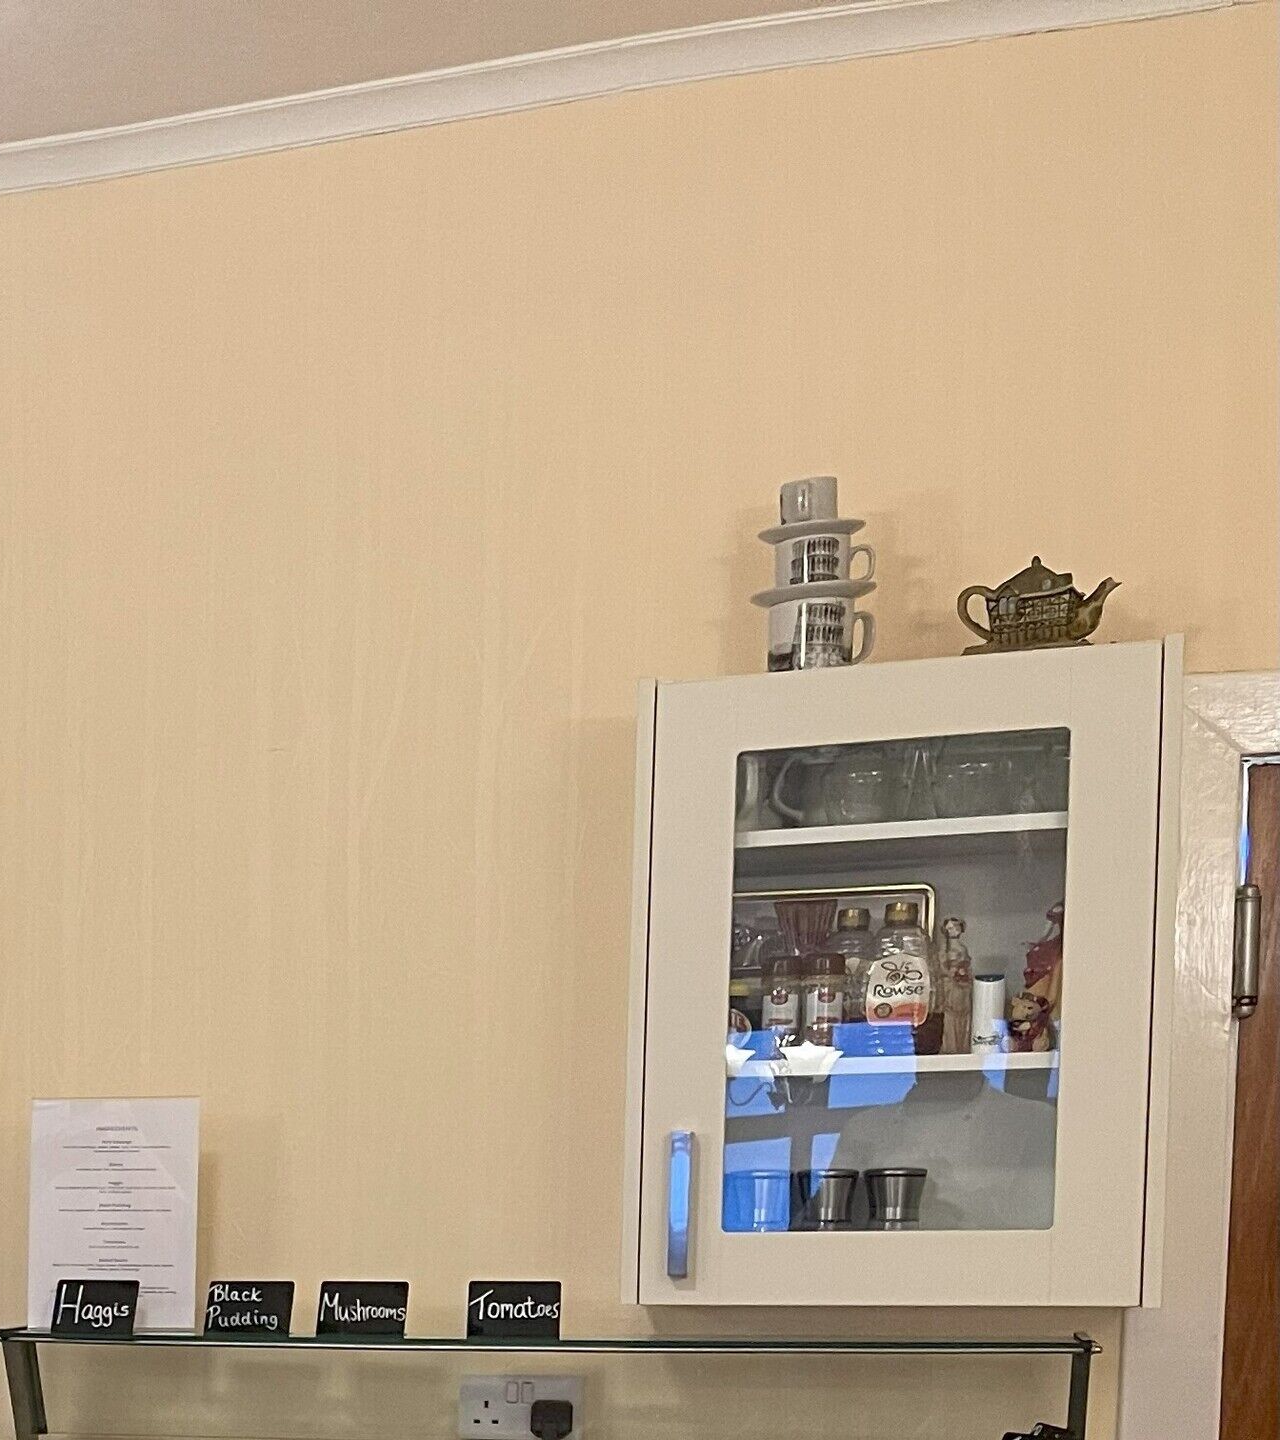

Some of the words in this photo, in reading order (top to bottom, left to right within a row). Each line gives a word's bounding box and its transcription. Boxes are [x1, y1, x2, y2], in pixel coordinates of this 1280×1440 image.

[872, 984, 925, 998] Rowse
[56, 1283, 130, 1328] Haggis
[208, 1284, 264, 1303] Black
[319, 1291, 406, 1323] Mushrooms
[469, 1289, 560, 1321] Tomatoes
[207, 1305, 278, 1331] Pudding
